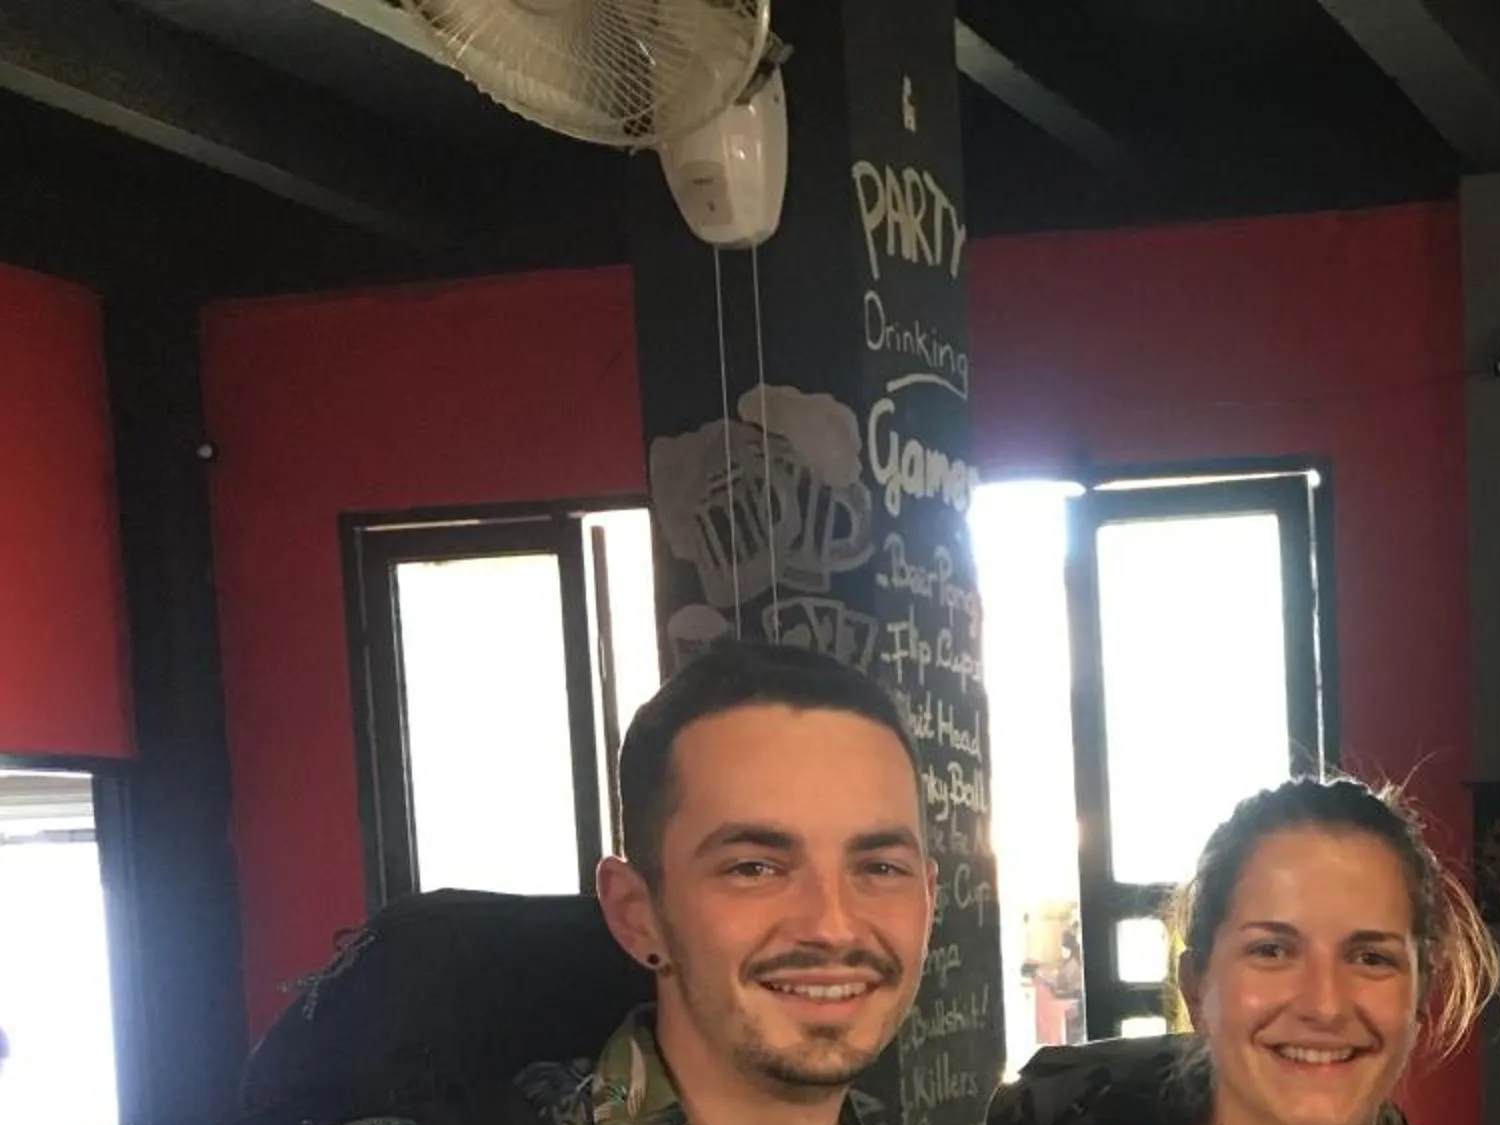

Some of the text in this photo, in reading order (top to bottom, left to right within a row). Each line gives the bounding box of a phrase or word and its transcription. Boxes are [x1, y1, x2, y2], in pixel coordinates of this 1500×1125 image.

[852, 159, 966, 280] PARTY
[863, 290, 968, 390] Drinking
[938, 698, 983, 762] Head
[922, 762, 988, 822] ky Ball
[914, 1052, 978, 1108] Killers
